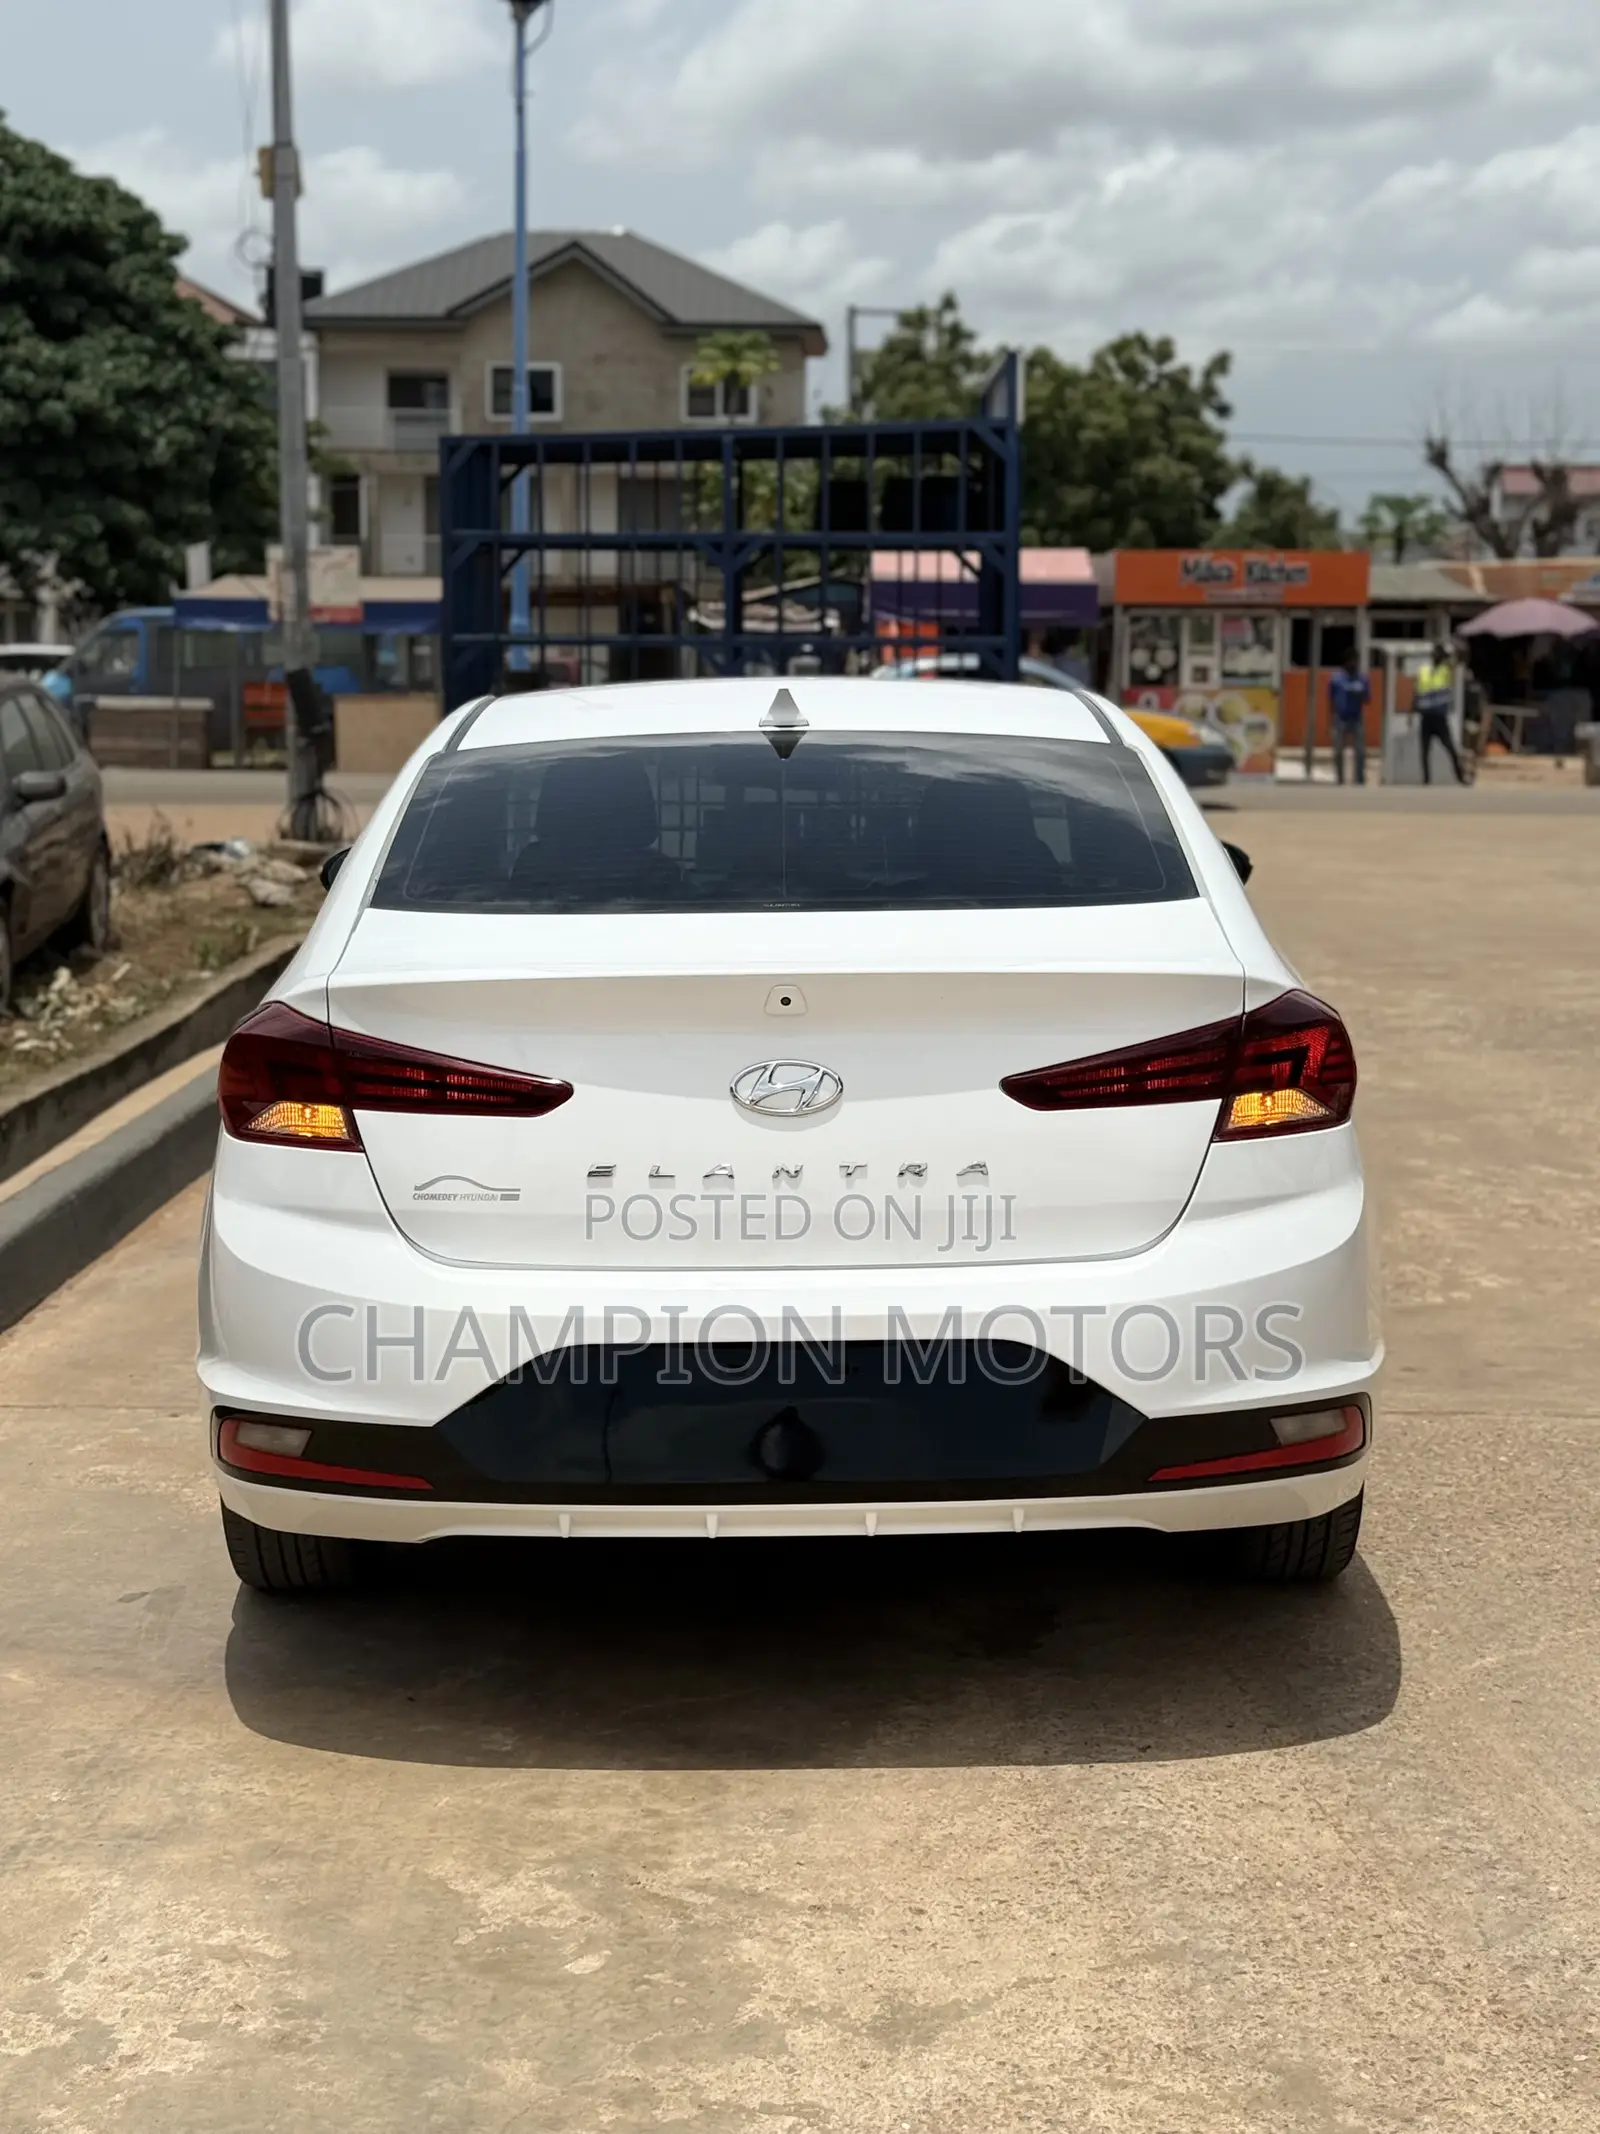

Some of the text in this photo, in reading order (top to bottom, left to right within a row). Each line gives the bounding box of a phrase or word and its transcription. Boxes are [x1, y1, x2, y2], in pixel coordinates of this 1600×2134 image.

[586, 1163, 989, 1179] ELANTRA
[412, 1193, 499, 1202] CHOMEDEY HYUNDAI
